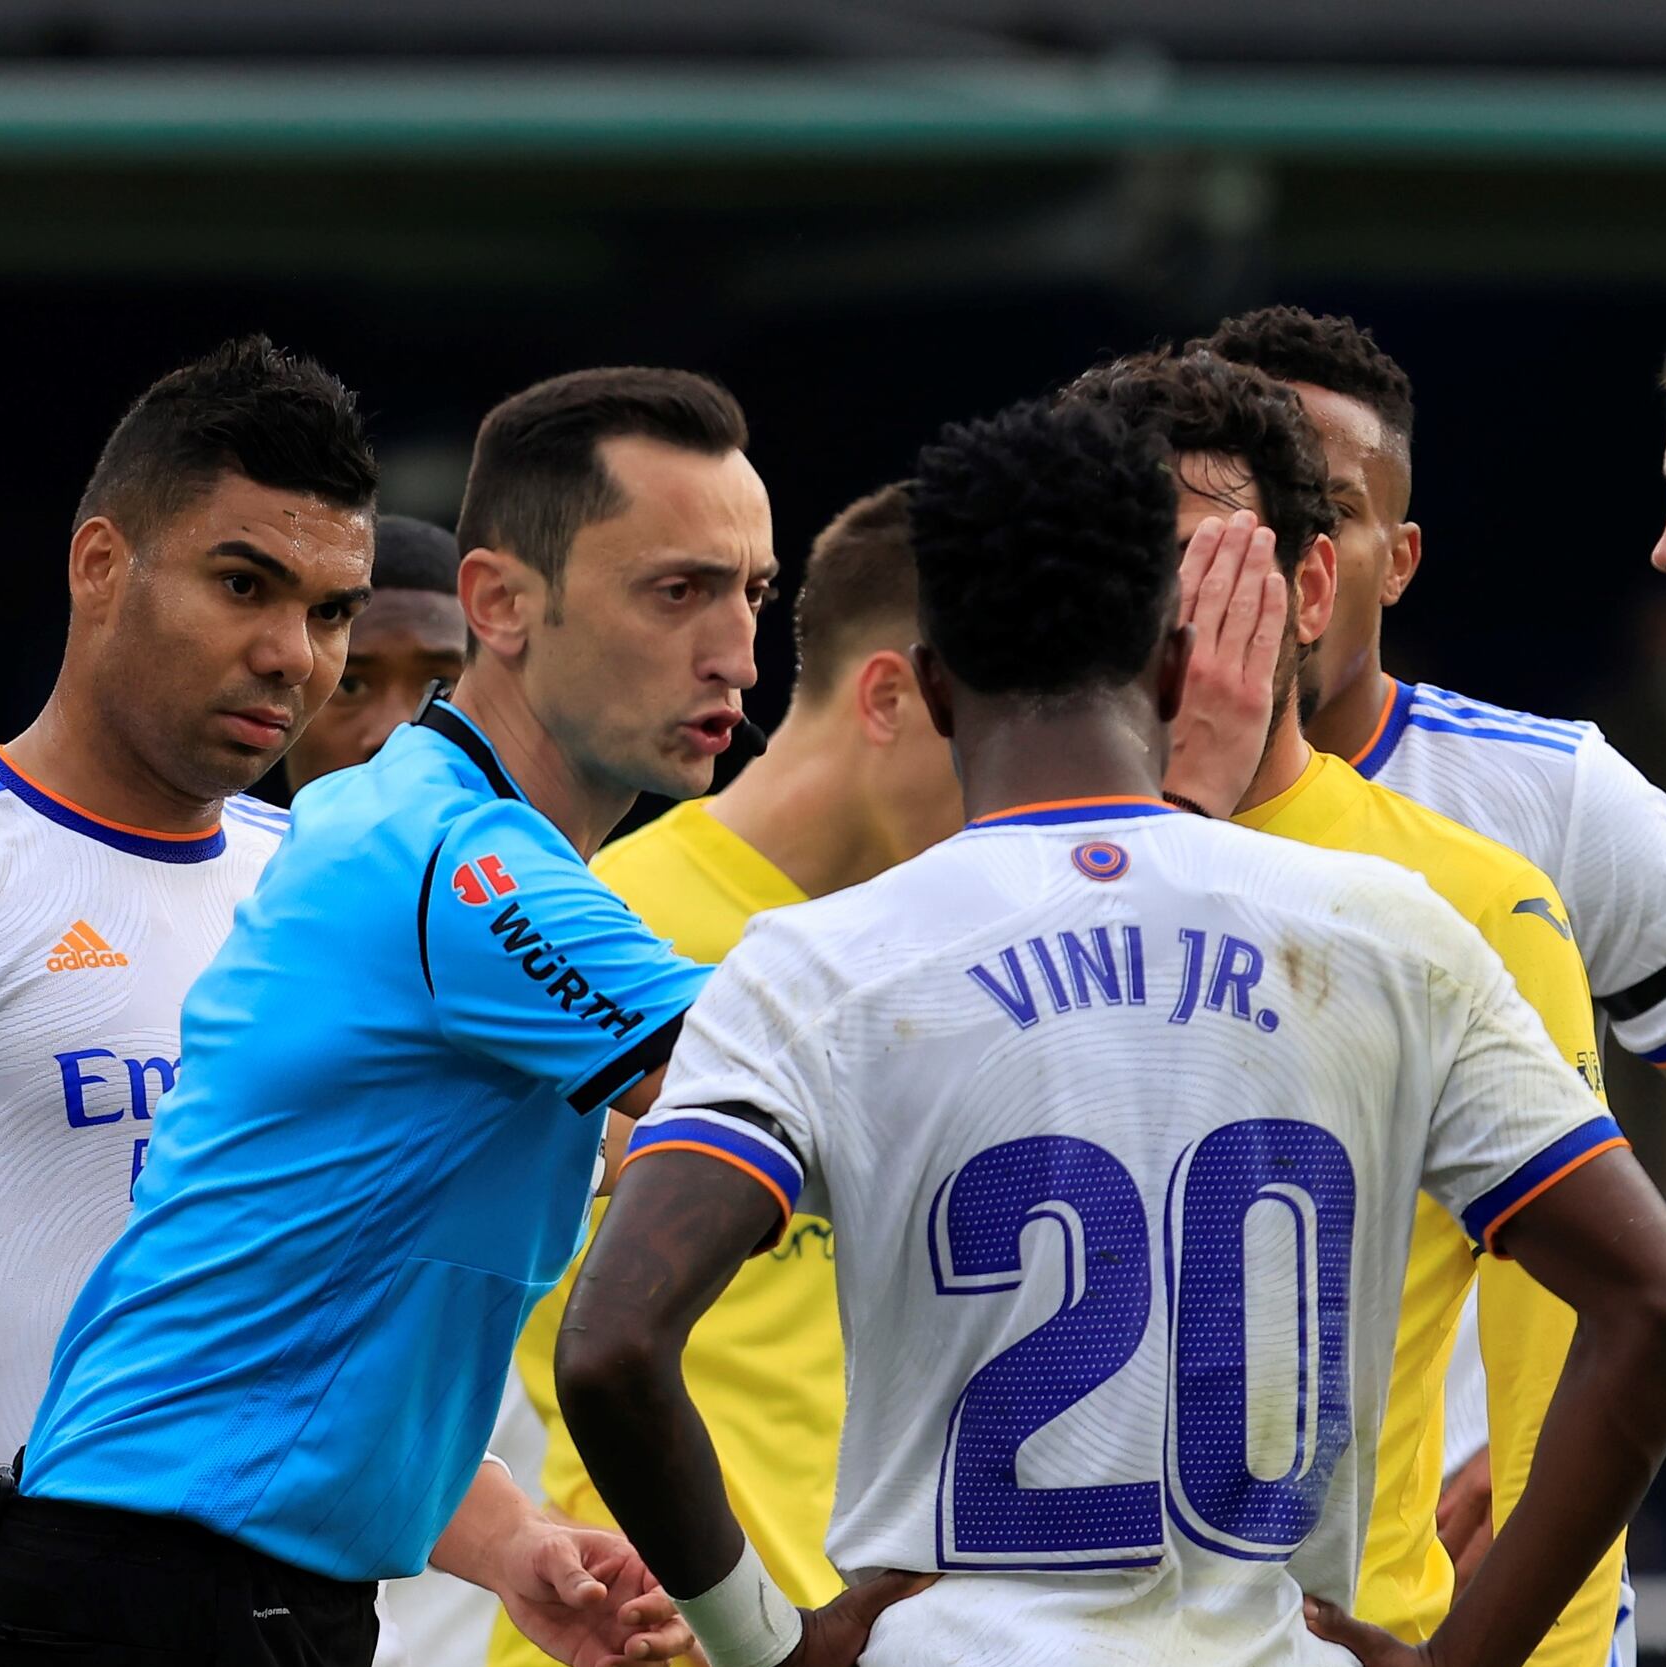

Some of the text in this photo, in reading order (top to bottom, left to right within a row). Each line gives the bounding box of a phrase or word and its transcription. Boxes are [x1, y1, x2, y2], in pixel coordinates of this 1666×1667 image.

[46, 951, 129, 973] adidas
[489, 902, 646, 1040] WÜRTH
[966, 926, 1280, 1033] VINI JR.
[928, 1117, 1357, 1570] 20
